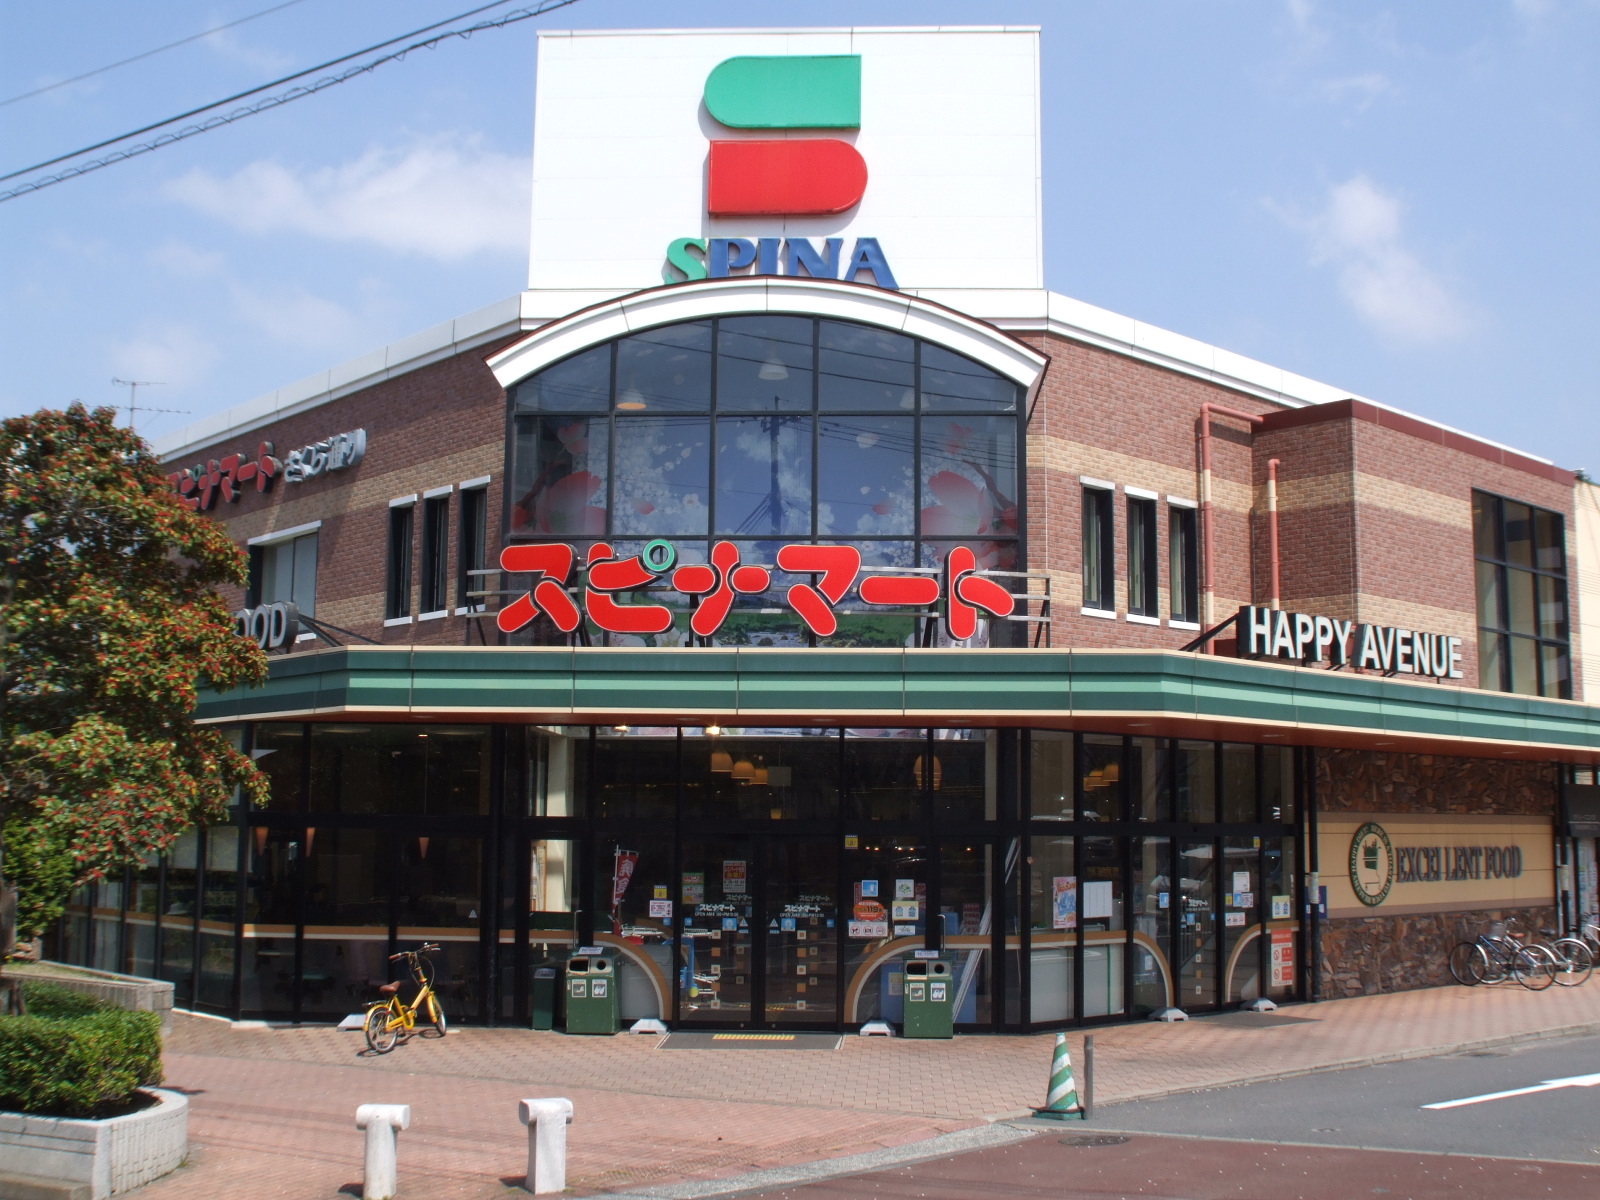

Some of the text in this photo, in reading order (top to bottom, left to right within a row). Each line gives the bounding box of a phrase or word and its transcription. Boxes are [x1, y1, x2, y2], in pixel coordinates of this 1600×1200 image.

[662, 237, 900, 290] SPINA
[496, 539, 1016, 641] スピナマート
[1246, 605, 1464, 679] HAPPY AVENUE
[1484, 845, 1522, 879] FOOD
